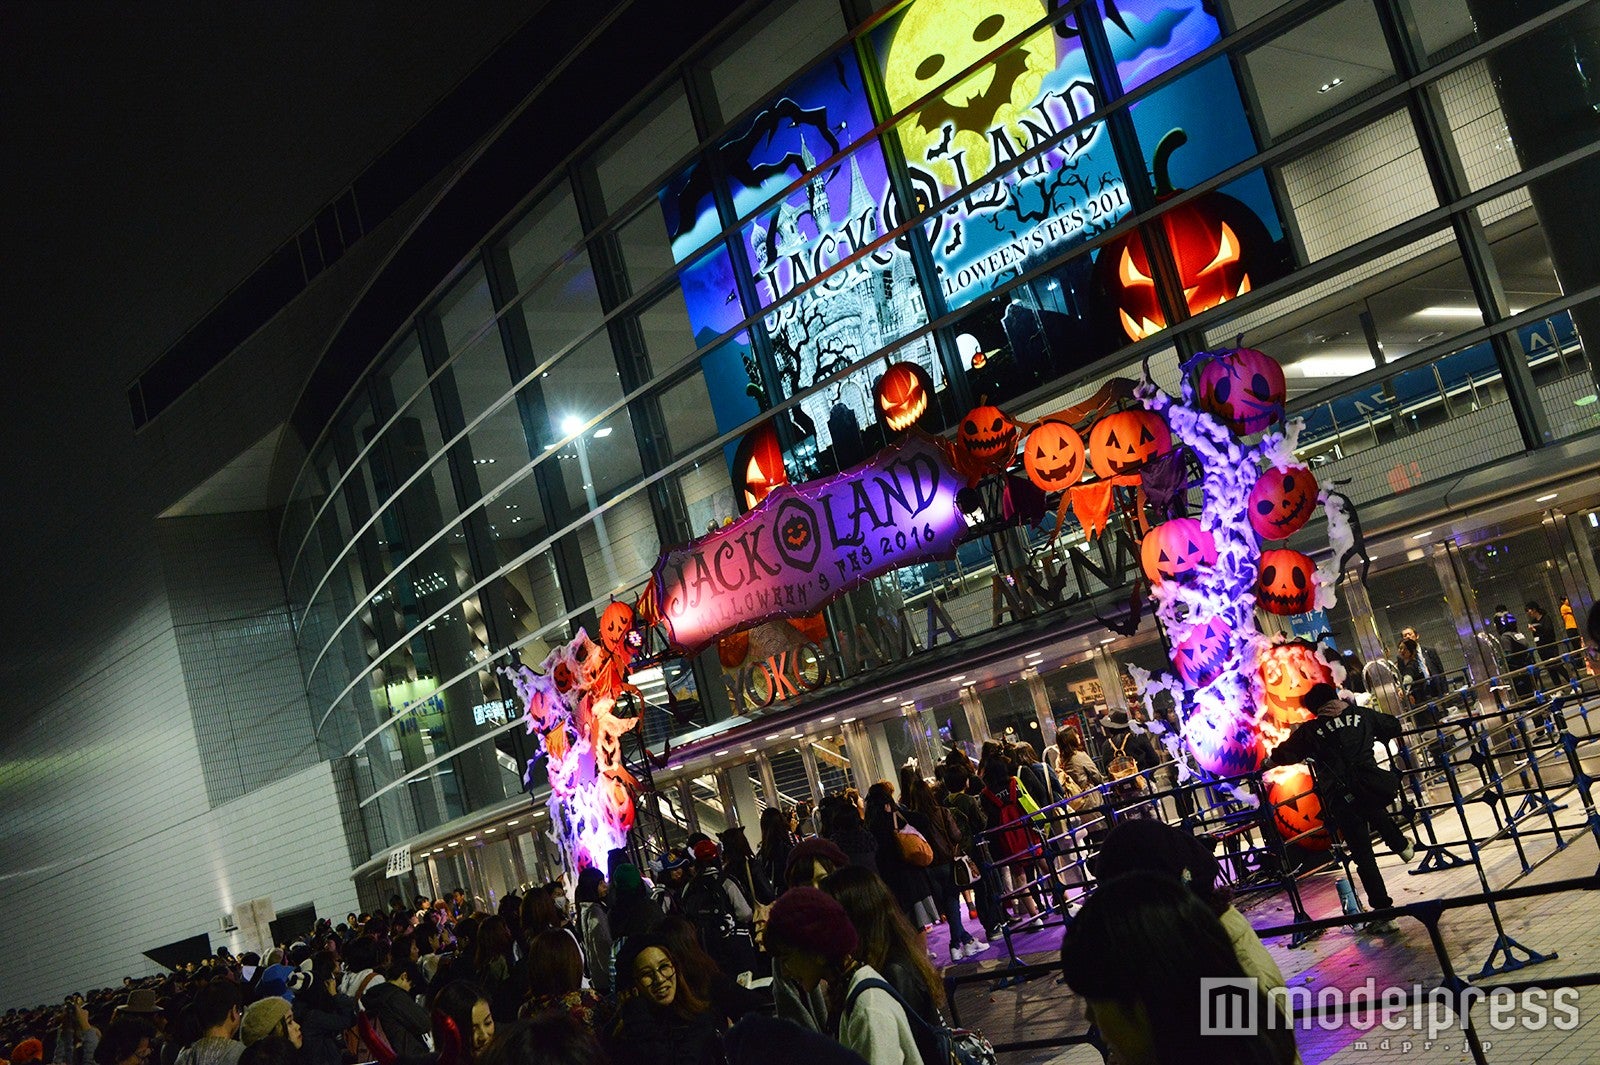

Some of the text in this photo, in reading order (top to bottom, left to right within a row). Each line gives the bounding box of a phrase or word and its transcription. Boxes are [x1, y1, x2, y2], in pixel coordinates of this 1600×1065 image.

[912, 187, 1129, 314] HLOWEEN'S FES 201
[880, 522, 935, 556] 2016
